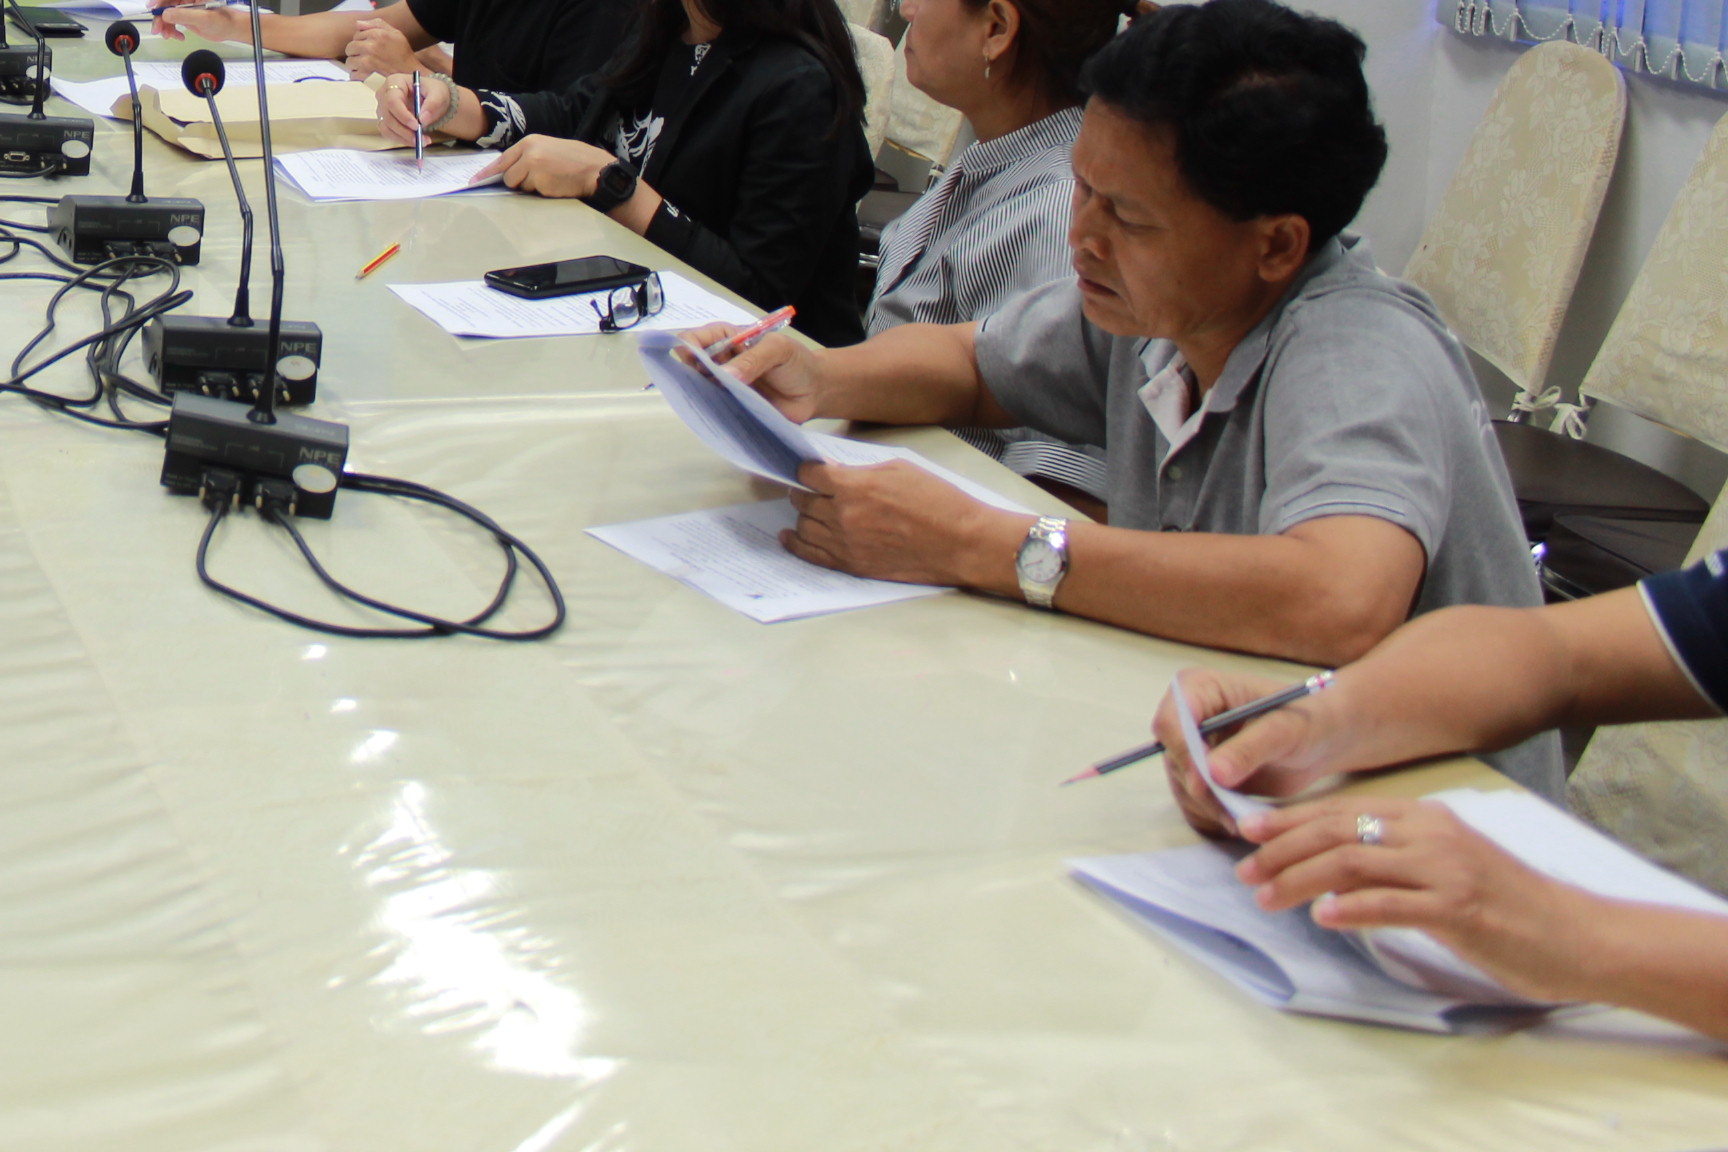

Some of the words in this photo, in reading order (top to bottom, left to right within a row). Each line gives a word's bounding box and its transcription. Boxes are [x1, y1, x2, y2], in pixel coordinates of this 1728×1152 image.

[26, 55, 50, 63] NE
[63, 129, 91, 139] NPE
[170, 213, 200, 223] NPE
[280, 341, 318, 352] NPE
[299, 446, 341, 464] NPE
